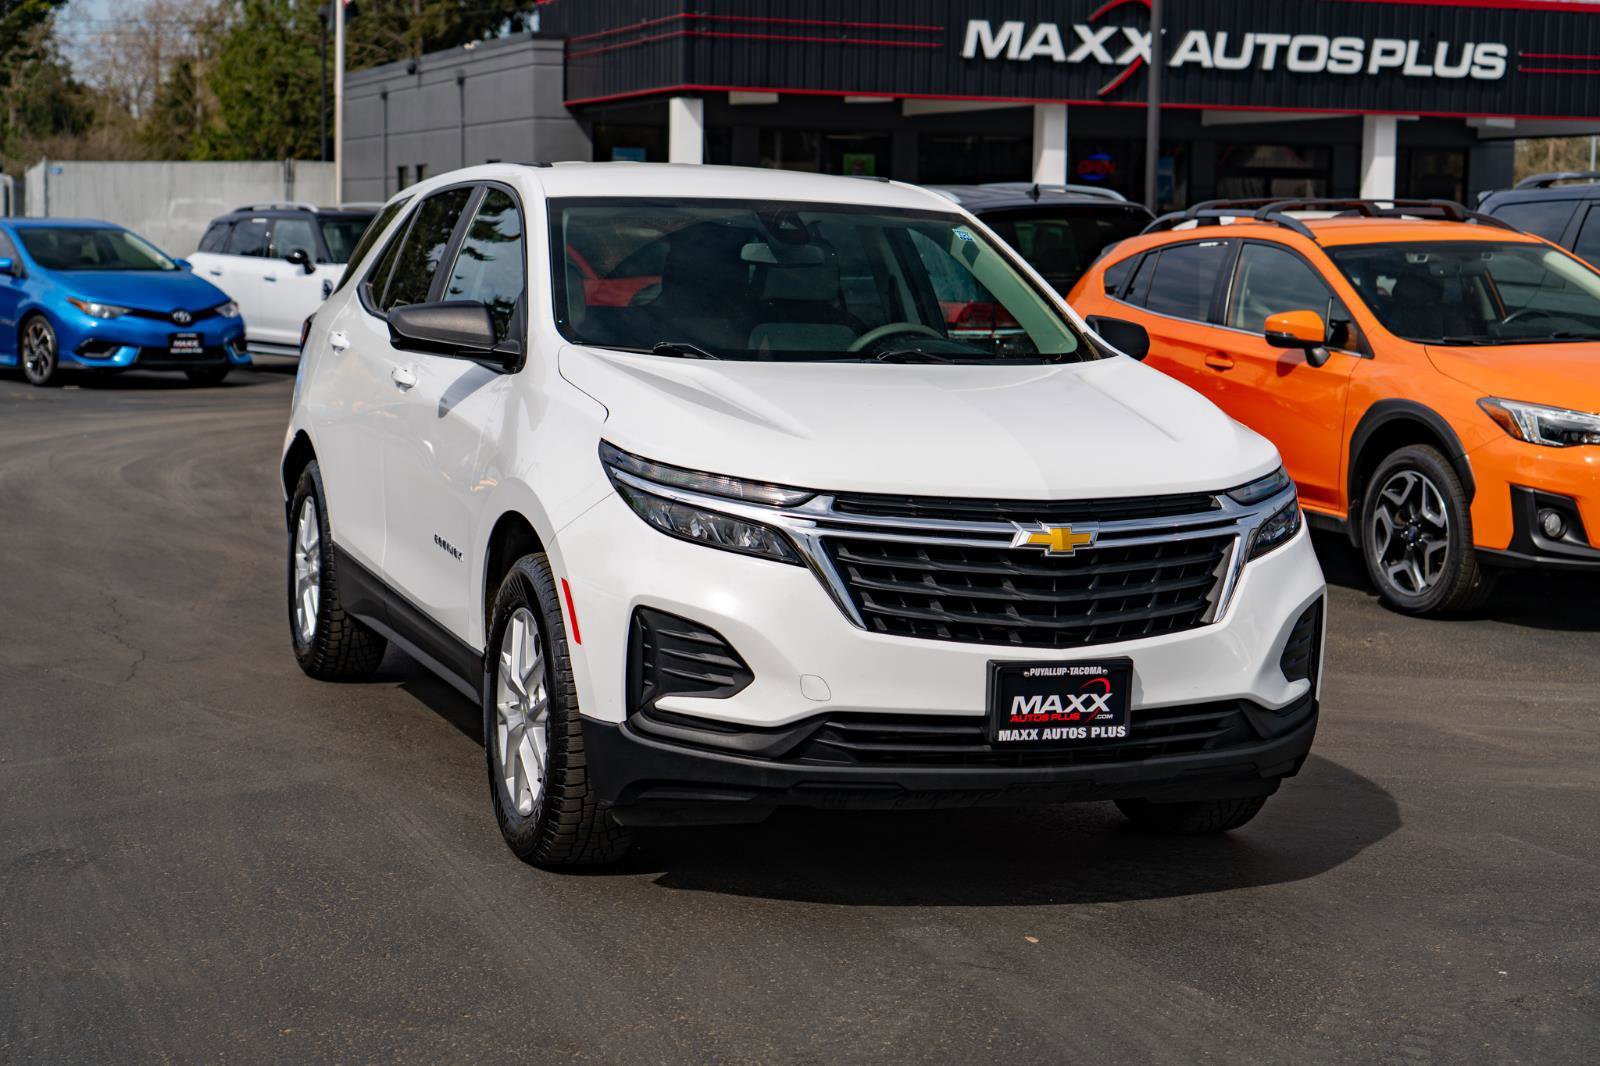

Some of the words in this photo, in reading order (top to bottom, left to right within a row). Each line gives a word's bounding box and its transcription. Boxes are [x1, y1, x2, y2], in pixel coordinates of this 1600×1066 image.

[962, 19, 1152, 65] MAXX
[1168, 30, 1365, 75] AUTOS
[1367, 38, 1508, 80] PLUS
[1010, 692, 1113, 715] MAXX
[1009, 713, 1050, 723] AUTOS
[998, 729, 1039, 742] MAXX
[1042, 727, 1087, 740] AUTOS
[1091, 725, 1126, 738] PLUS
